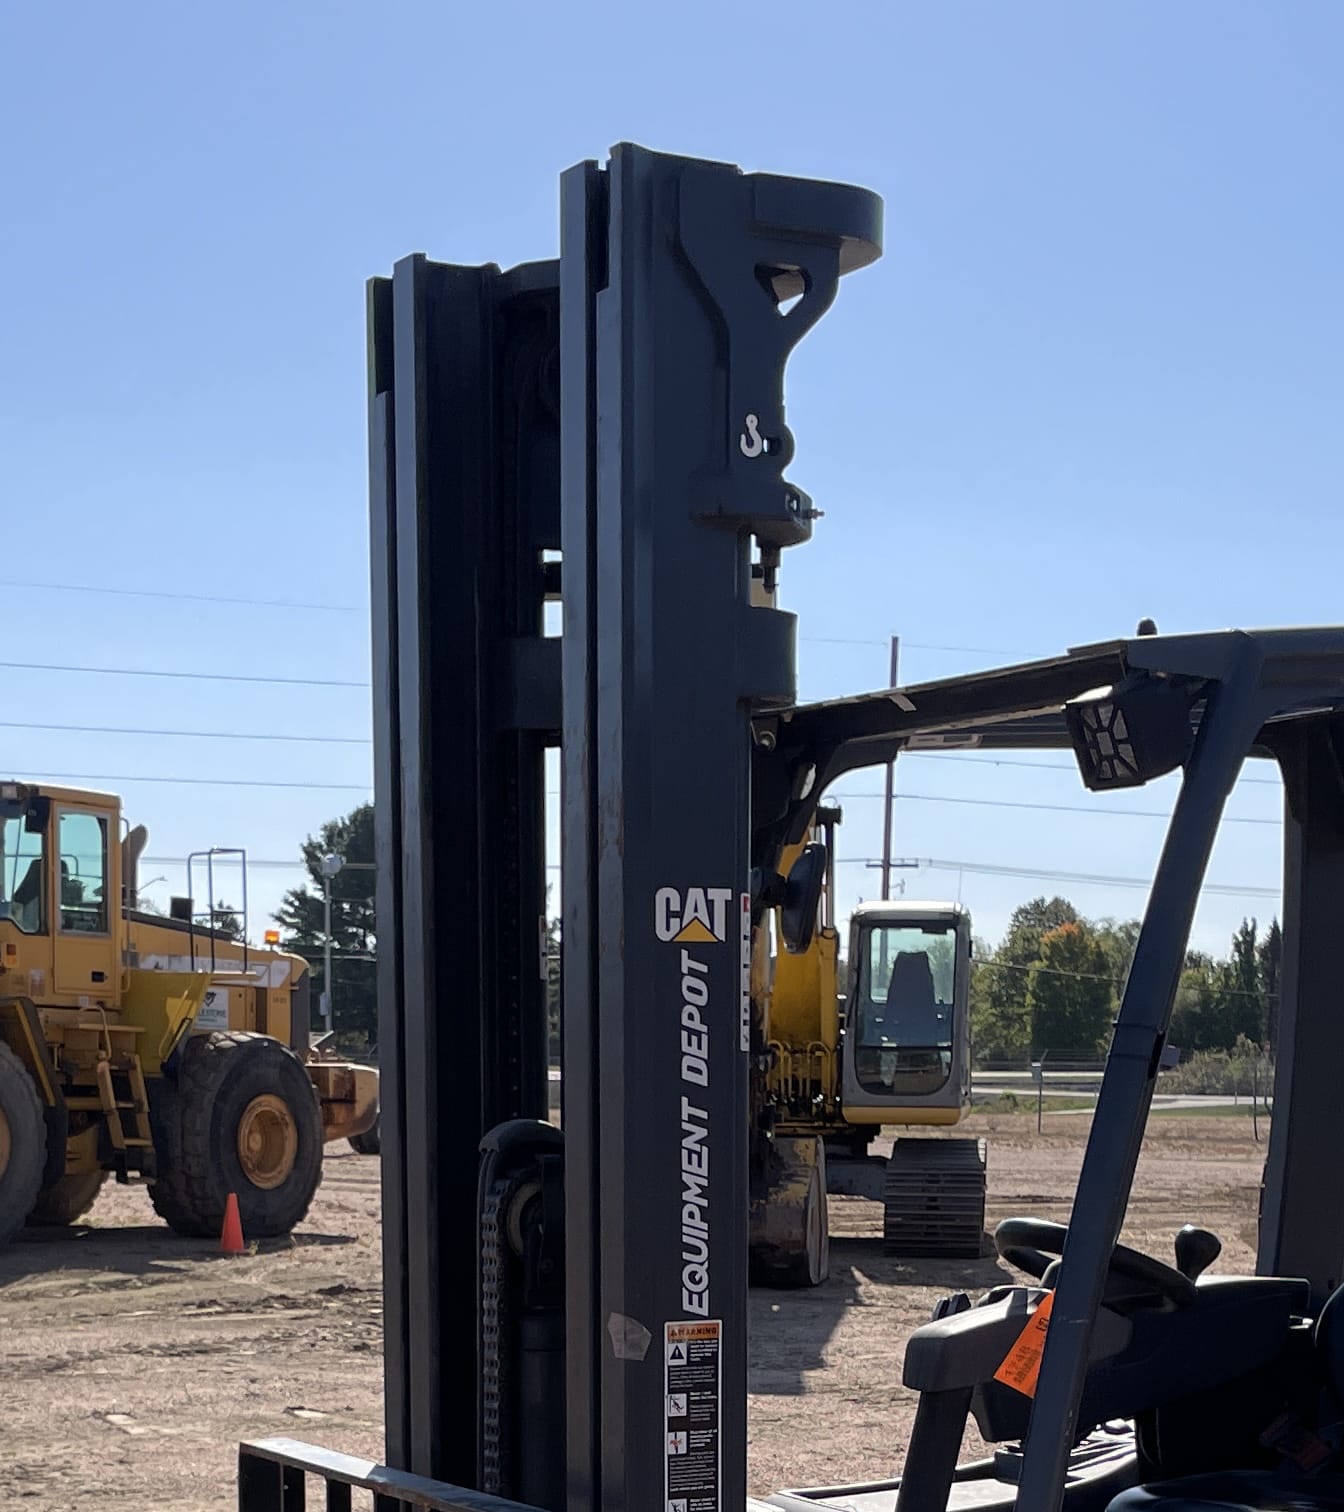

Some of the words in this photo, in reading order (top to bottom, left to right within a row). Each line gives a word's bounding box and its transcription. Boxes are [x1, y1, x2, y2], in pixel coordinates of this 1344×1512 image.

[655, 886, 733, 943] CAT
[680, 948, 709, 1087] DEPOT
[680, 1095, 709, 1317] EQUIPMENT
